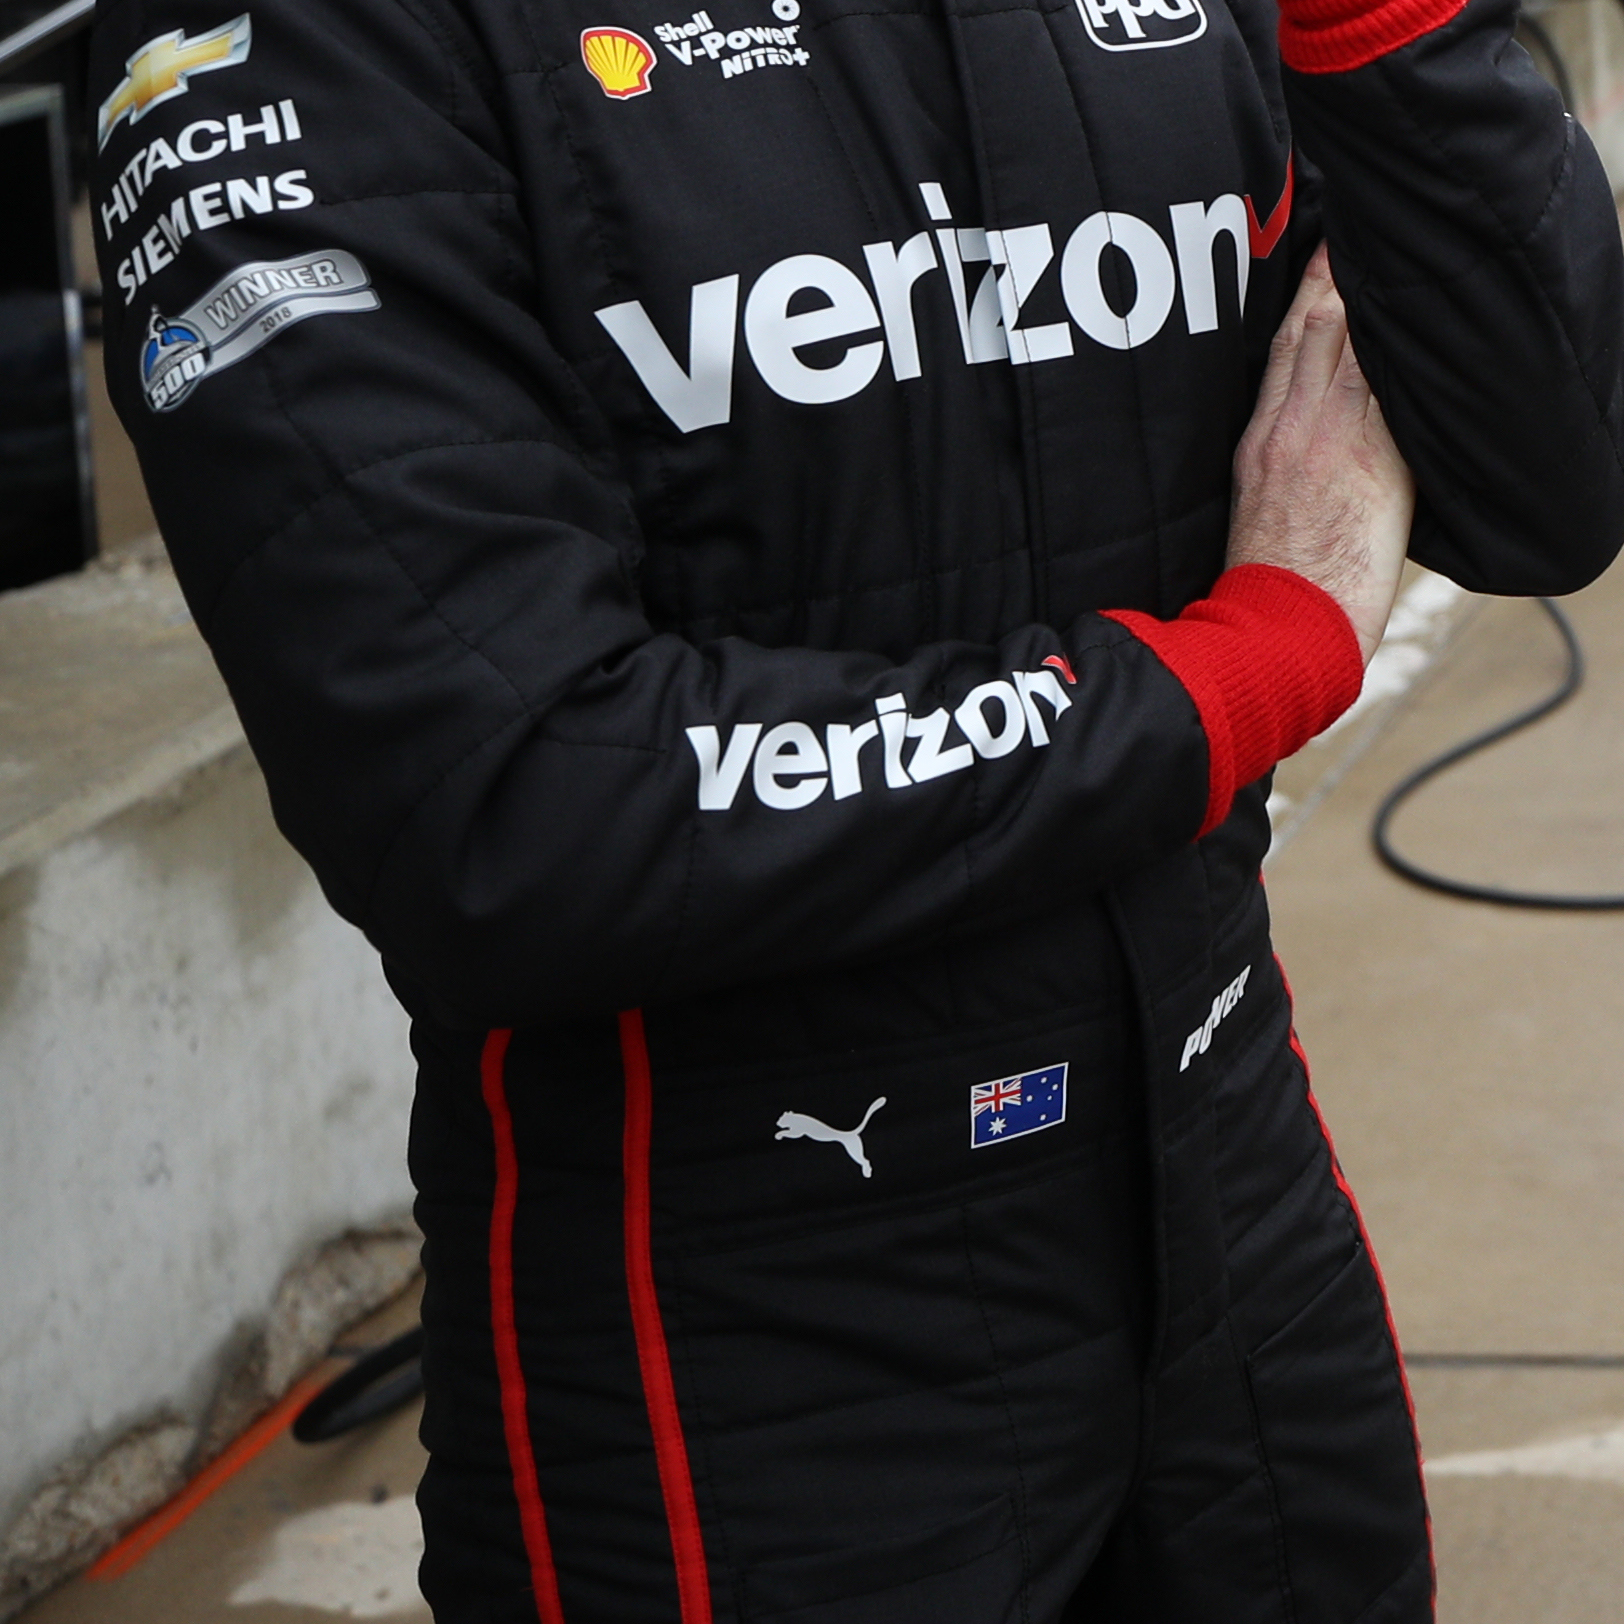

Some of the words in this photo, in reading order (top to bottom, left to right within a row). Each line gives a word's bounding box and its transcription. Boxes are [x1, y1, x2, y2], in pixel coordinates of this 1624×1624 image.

[653, 10, 714, 42] Shell
[664, 25, 800, 66] V-Power
[101, 98, 302, 242] HITACHI
[117, 169, 315, 306] SIEMENS
[203, 258, 344, 331] WINNER
[259, 306, 293, 333] 2018
[594, 182, 1250, 434] verizon
[149, 352, 206, 410] 500
[685, 669, 1074, 811] verizon
[1179, 964, 1251, 1073] POWER
